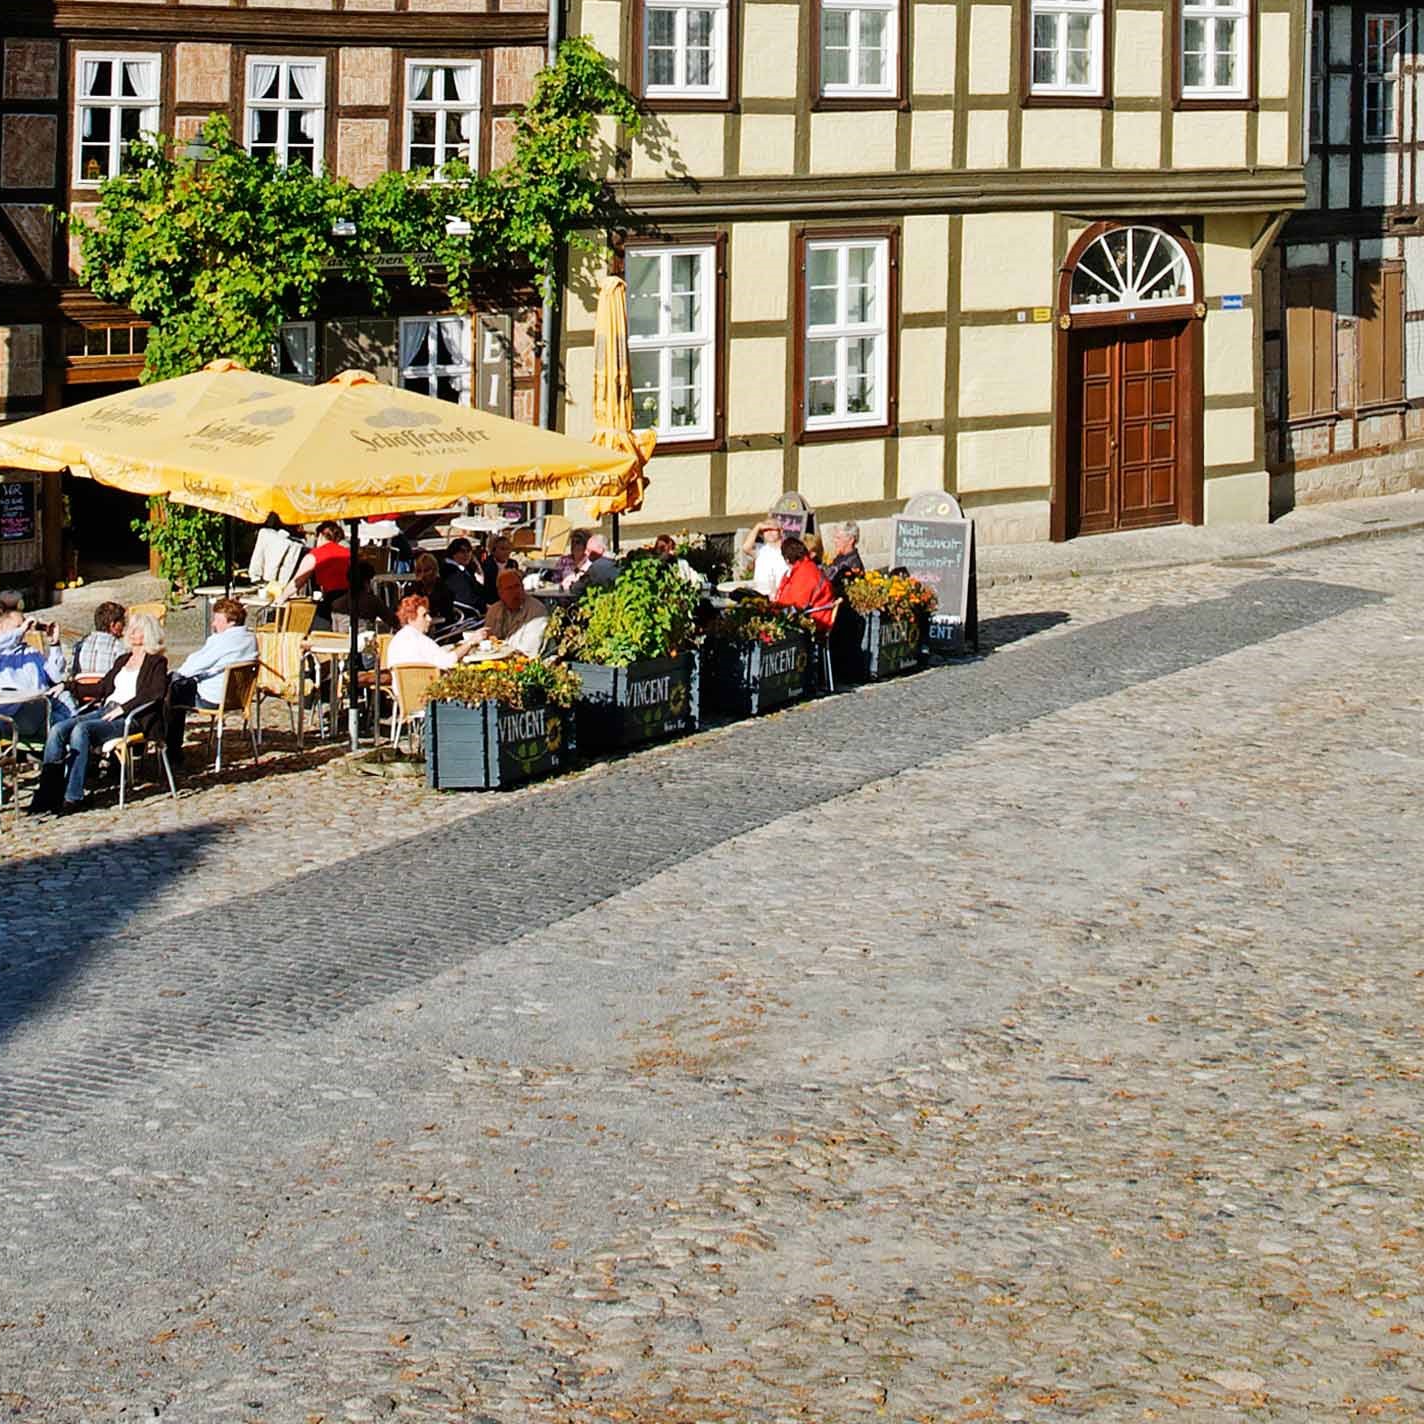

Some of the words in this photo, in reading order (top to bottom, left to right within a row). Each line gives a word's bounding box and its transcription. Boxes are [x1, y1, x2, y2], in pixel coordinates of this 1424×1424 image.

[350, 426, 491, 453] Schöfferhofer
[760, 646, 797, 679] VINCENT
[626, 676, 672, 707] VINCENT
[498, 709, 546, 743] VINCENT
